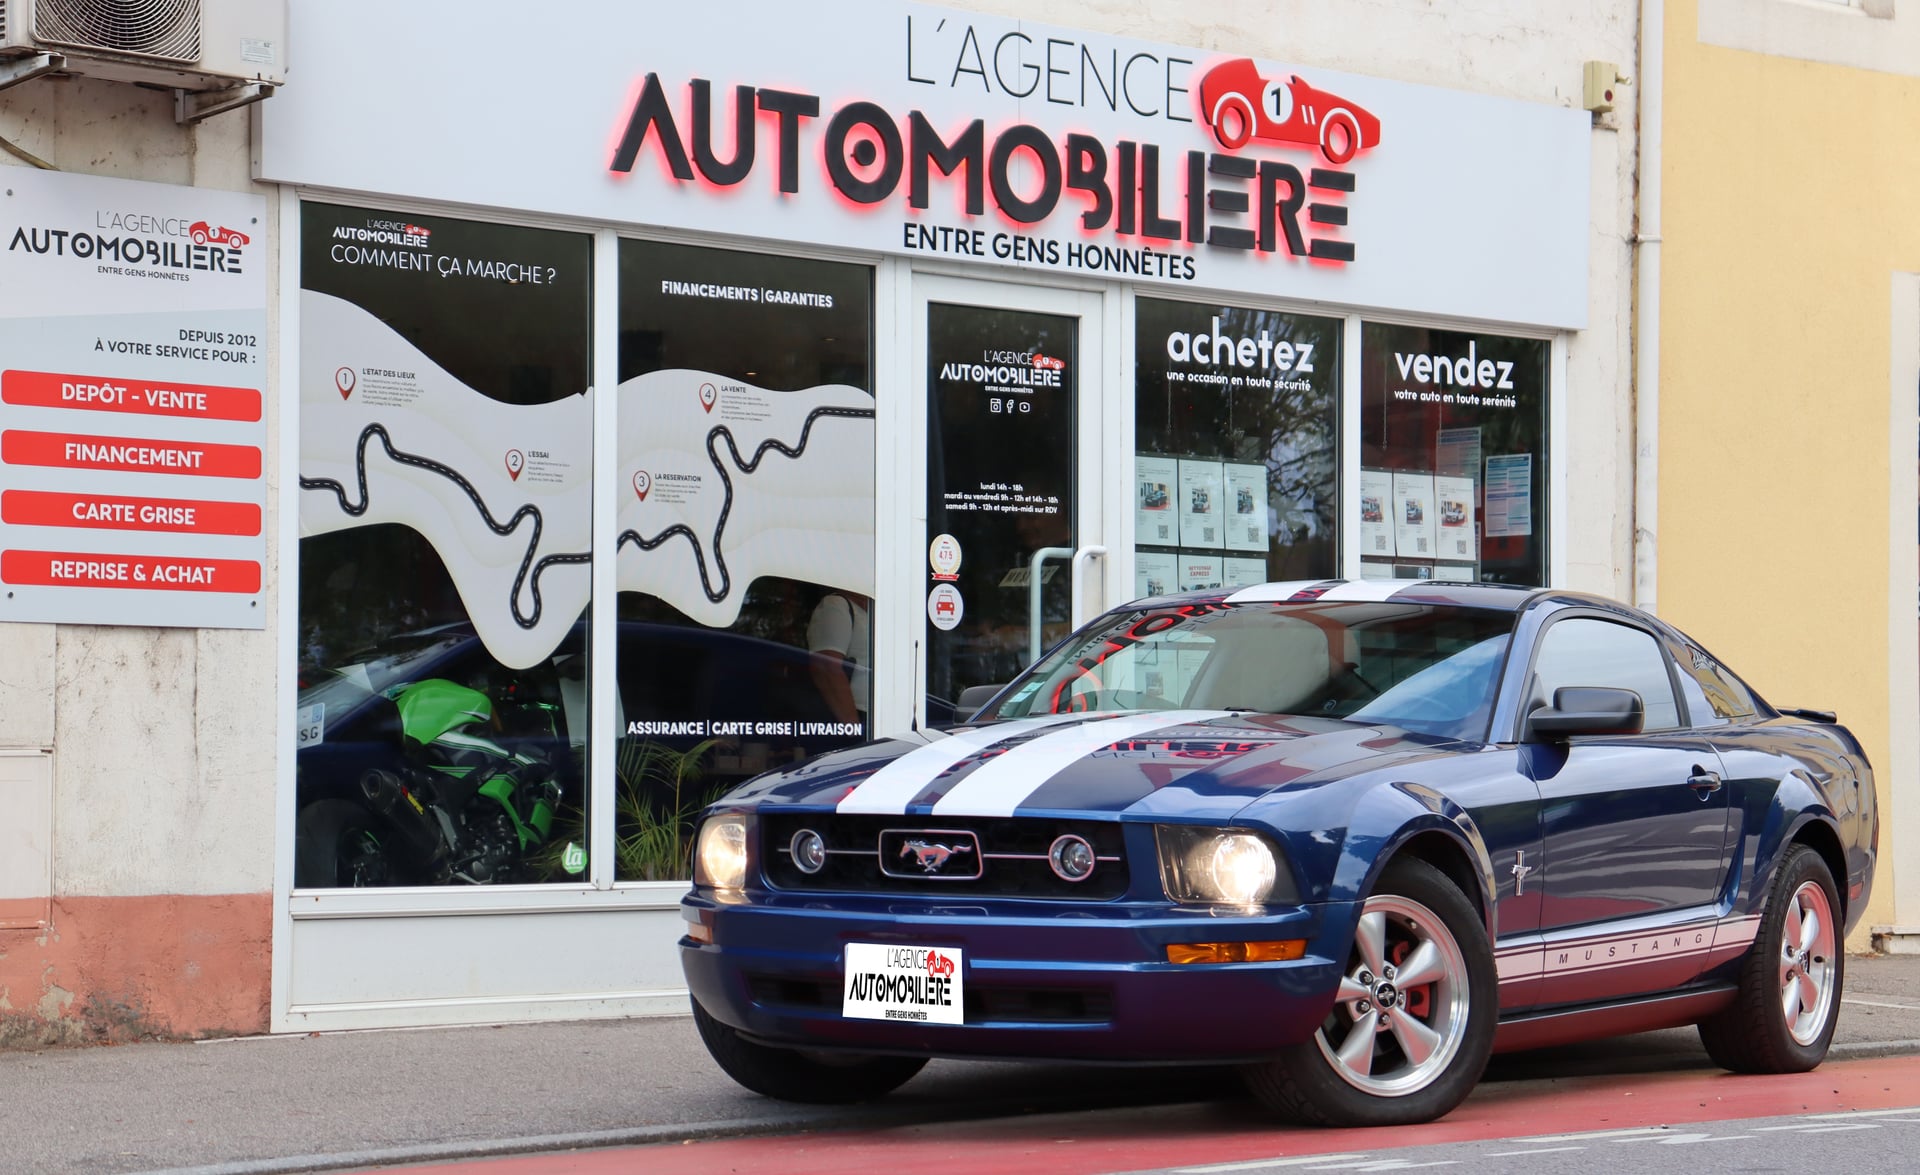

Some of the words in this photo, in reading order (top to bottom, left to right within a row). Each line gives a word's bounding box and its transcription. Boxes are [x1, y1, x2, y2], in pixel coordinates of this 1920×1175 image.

[906, 14, 1194, 124] L'AGENCE
[96, 210, 190, 238] L'AGENCE
[904, 223, 986, 257] ENTRE
[991, 230, 1061, 266] GENS
[1066, 240, 1197, 281] HONNÊTES
[97, 265, 123, 276] ENTRE
[124, 267, 147, 278] GENS
[147, 269, 190, 282] HONNÊTES
[331, 244, 433, 272] COMMENT
[437, 255, 462, 278] ÇA
[466, 259, 543, 284] MARCHE
[546, 267, 557, 284] ?
[661, 280, 759, 301] FINANCEMENTS
[765, 289, 833, 308] GARANTIES
[179, 329, 224, 346] DEPUIS
[227, 333, 257, 348] 2012
[1167, 316, 1314, 373] achetez
[94, 336, 105, 352] À
[107, 341, 152, 357] VOTRE
[155, 344, 209, 361] SERVICE
[212, 349, 248, 364] POUR
[383, 370, 396, 378] DES
[396, 371, 416, 380] LIEUX
[1394, 340, 1514, 390] vendez
[729, 386, 747, 394] VENTE
[1166, 370, 1185, 382] une
[1187, 372, 1229, 385] occasion
[1230, 376, 1243, 386] en
[1245, 376, 1271, 389] toute
[1274, 377, 1311, 392] sécurité
[61, 382, 127, 405] DEPÔT
[144, 389, 208, 411] VENTE
[704, 388, 712, 400] 4
[1394, 389, 1418, 401] votre
[1420, 391, 1441, 403] auto
[1443, 394, 1454, 404] en
[1456, 393, 1480, 406] toute
[64, 442, 204, 469] FINANCEMENT
[511, 454, 518, 467] 2
[638, 475, 645, 487] 3
[654, 473, 661, 481] LA
[663, 474, 702, 482] RESERVATION
[980, 482, 996, 491] lundi
[996, 483, 1007, 491] 14h
[1013, 484, 1023, 492] 18h
[944, 491, 963, 500] mardi
[973, 493, 1000, 501] vendredi
[1000, 493, 1009, 501] 9h
[1014, 494, 1024, 502] 12h
[1025, 495, 1032, 503] et
[945, 502, 968, 510] samedi
[982, 503, 993, 511] 12h
[1001, 504, 1034, 514] après-midi
[1045, 506, 1058, 514] RDV
[72, 502, 135, 523] CARTE
[140, 505, 196, 526] GRISE
[50, 560, 129, 582] REPRISE
[132, 563, 147, 582] &
[151, 564, 215, 585] ACHAT
[627, 721, 704, 736] ASSURANCE
[711, 721, 753, 735] CARTE
[755, 721, 791, 736] GRISE
[799, 721, 862, 737] LIVRAISON
[887, 947, 928, 970] L'AGENCE
[1558, 933, 1703, 965] MUSTANG
[885, 1009, 897, 1018] ENTRE
